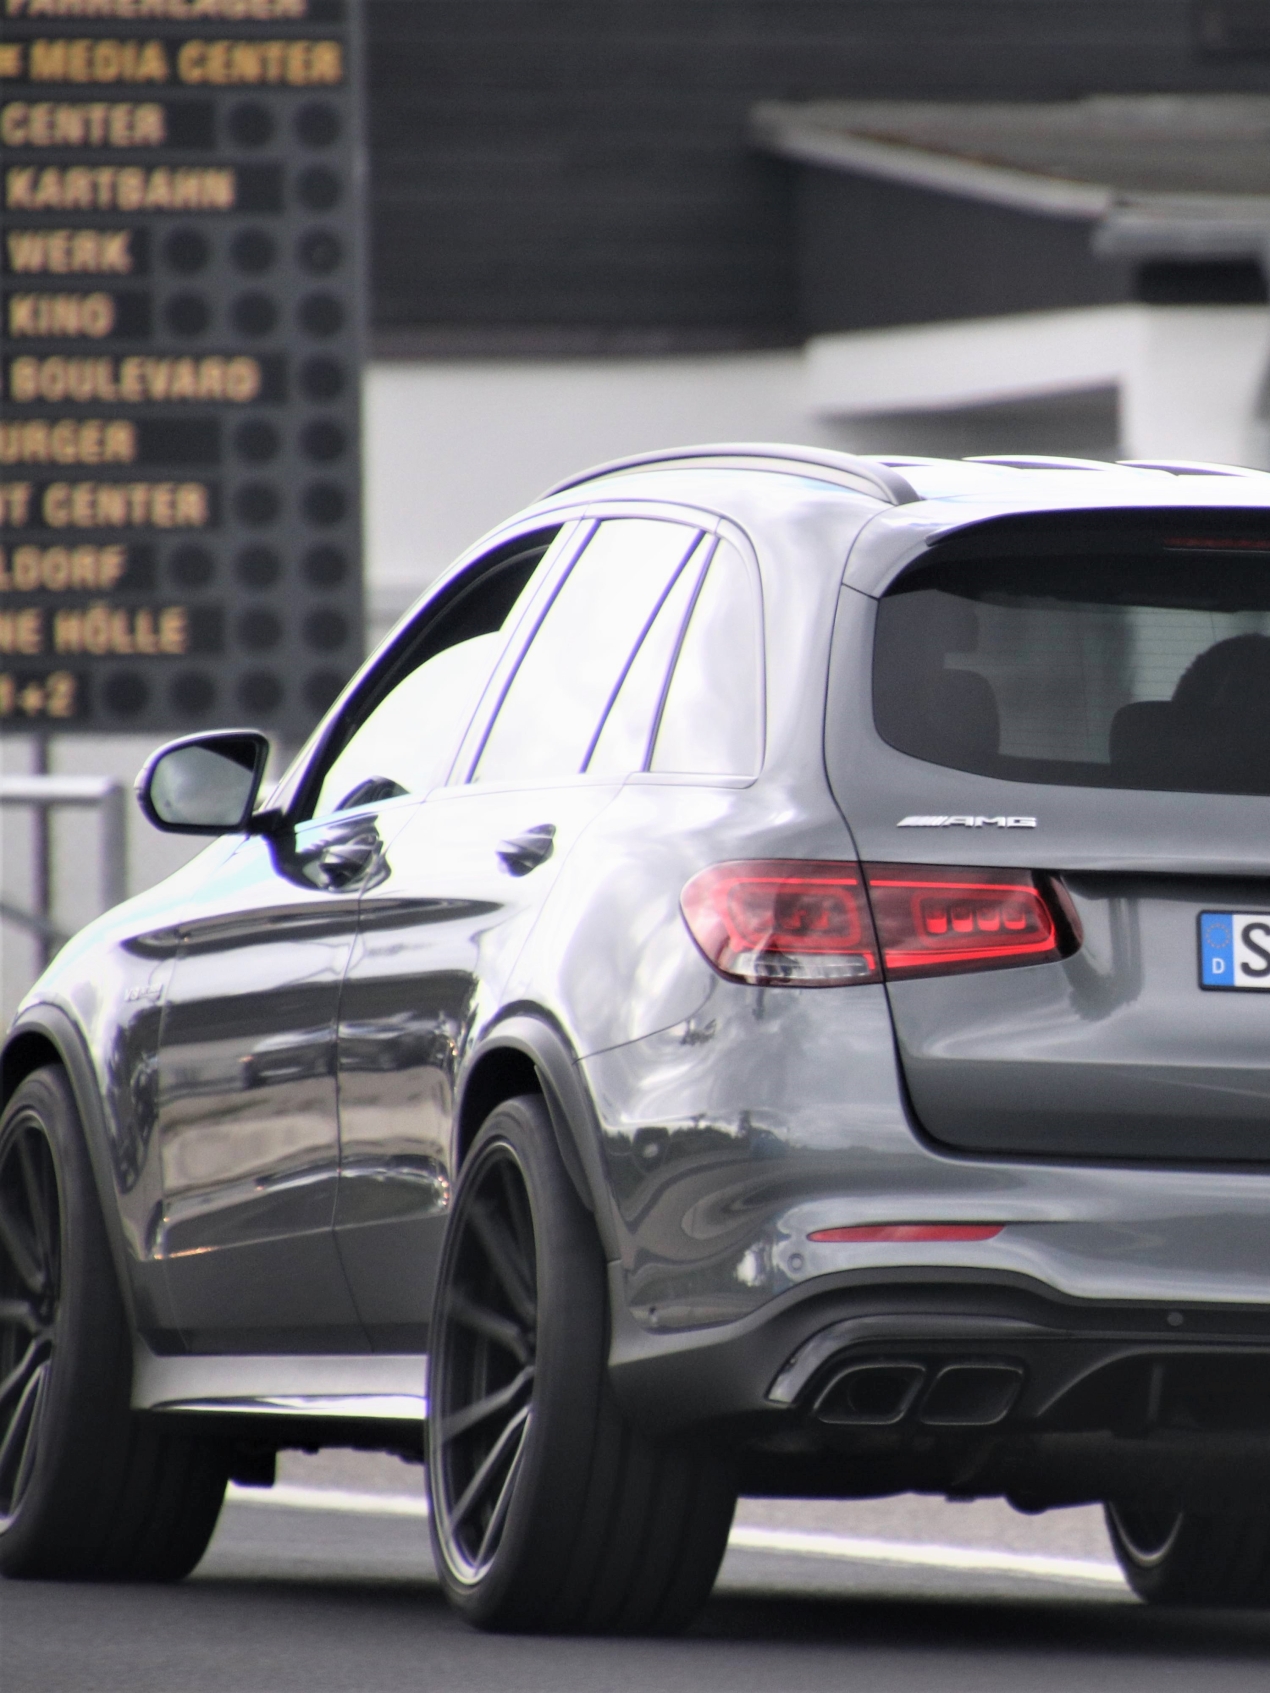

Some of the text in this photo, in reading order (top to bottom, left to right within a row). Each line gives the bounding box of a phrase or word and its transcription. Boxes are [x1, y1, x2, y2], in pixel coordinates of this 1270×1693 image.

[30, 40, 343, 85] MEDIA CENTER
[1, 103, 165, 146] CENTER
[7, 167, 235, 210] KARTBAHN
[8, 230, 131, 273] WERK
[10, 293, 114, 337] KINO
[11, 356, 260, 401] BOULEVARD
[43, 482, 207, 527] CENTER
[55, 602, 187, 654] HÖLLE
[940, 815, 1037, 828] AMG
[1212, 958, 1226, 974] D
